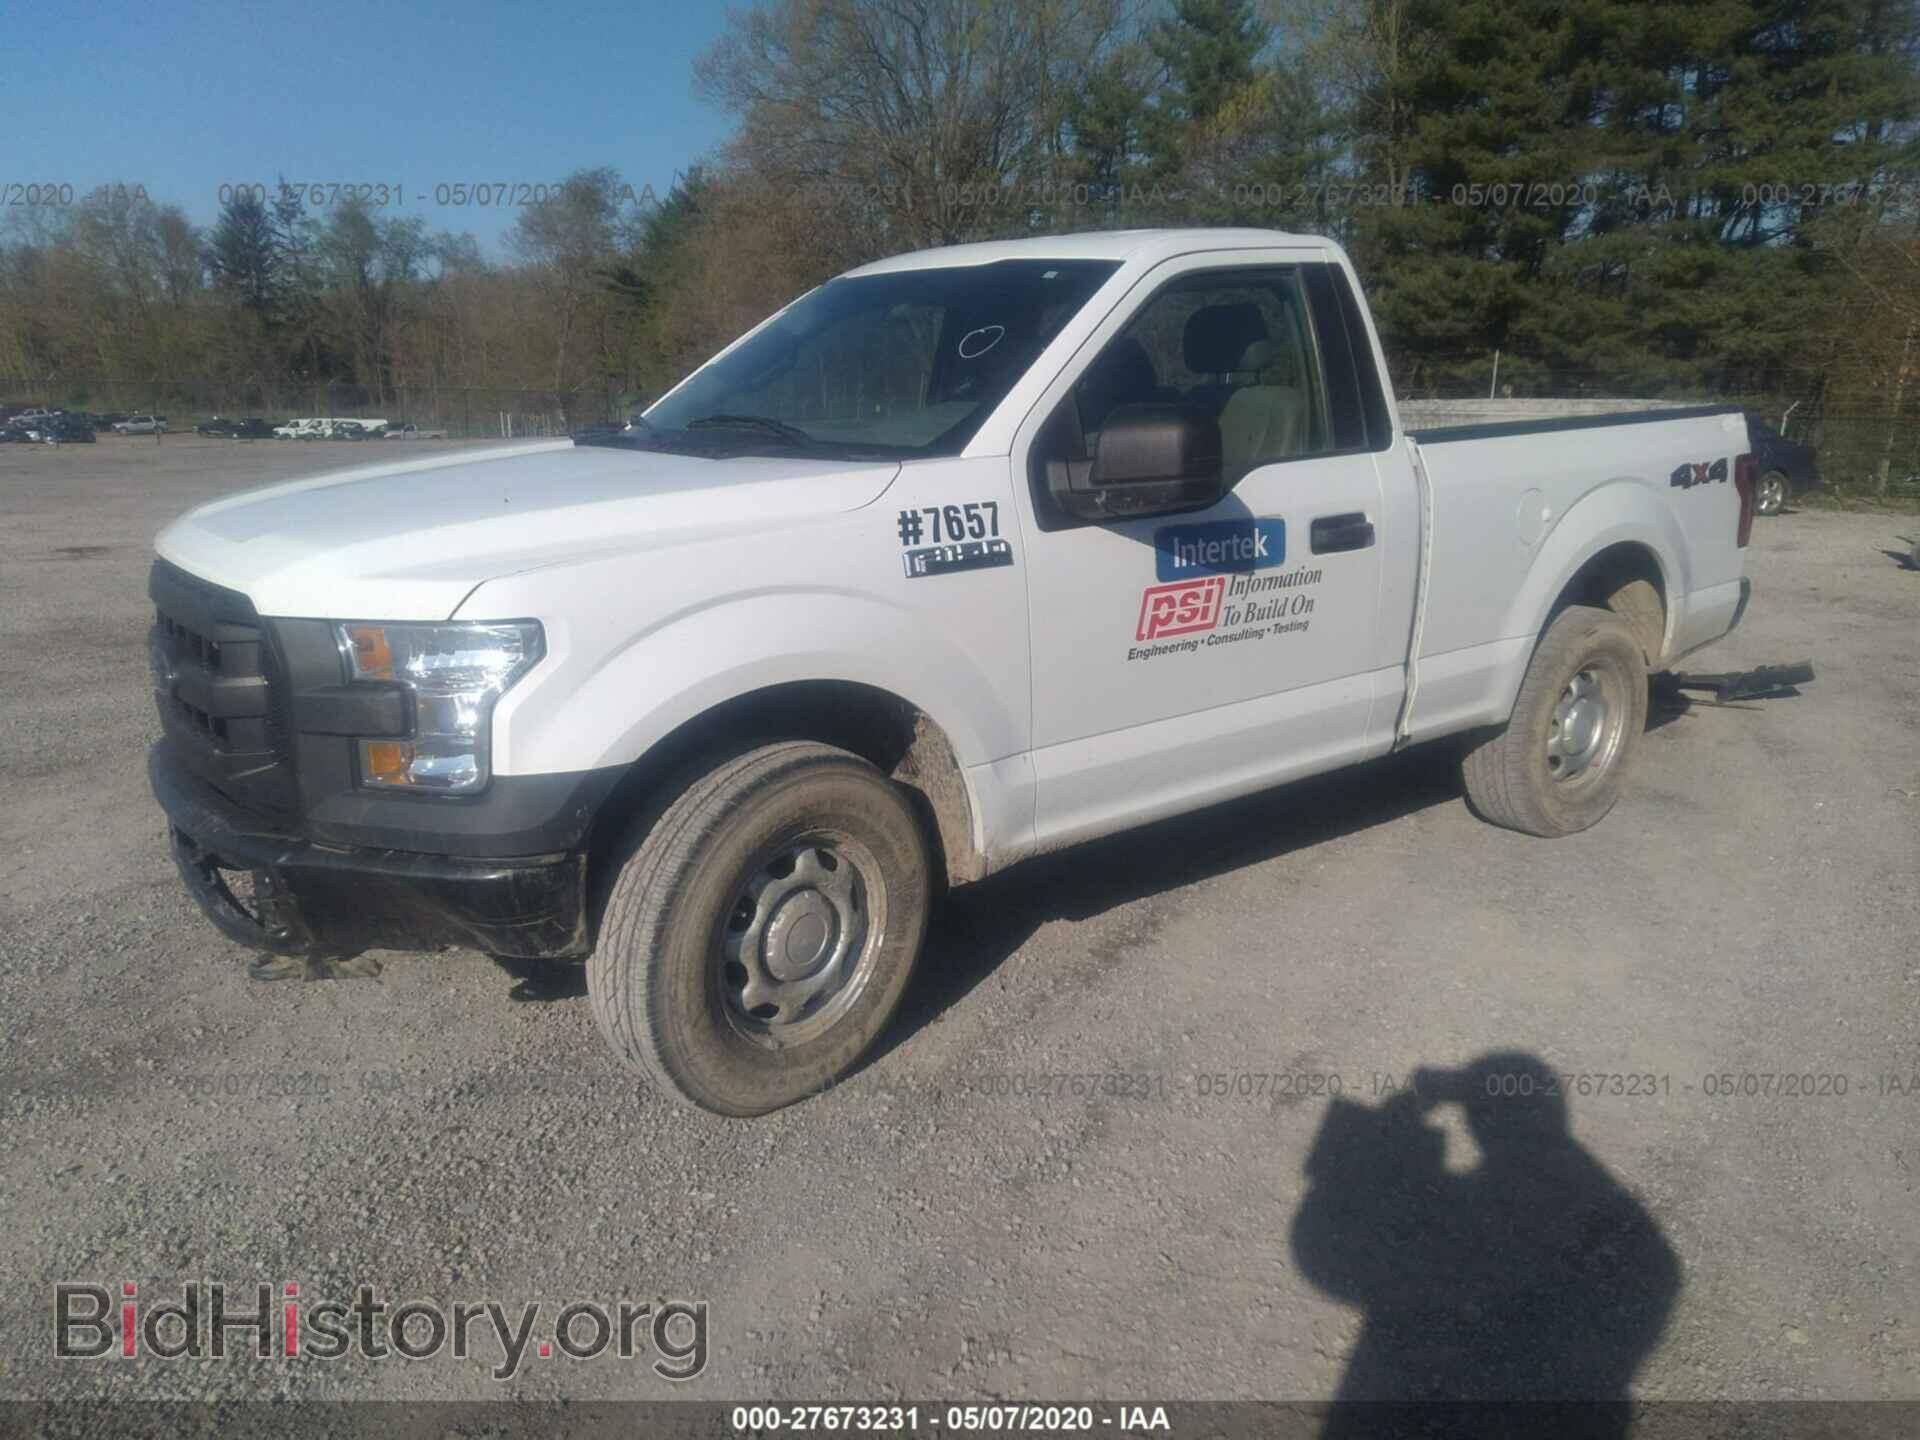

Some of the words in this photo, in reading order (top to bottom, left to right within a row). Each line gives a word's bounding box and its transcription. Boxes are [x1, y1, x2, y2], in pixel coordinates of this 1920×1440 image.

[898, 501, 999, 546] #7657
[1173, 527, 1269, 568] Intertek
[1228, 565, 1324, 600] Information
[1147, 578, 1215, 640] psi
[1223, 605, 1240, 627] To
[1245, 598, 1286, 624] Build
[1291, 594, 1315, 615] On
[1127, 639, 1199, 661] Engineering
[1207, 627, 1265, 647] Consulting
[1273, 620, 1311, 635] Testing
